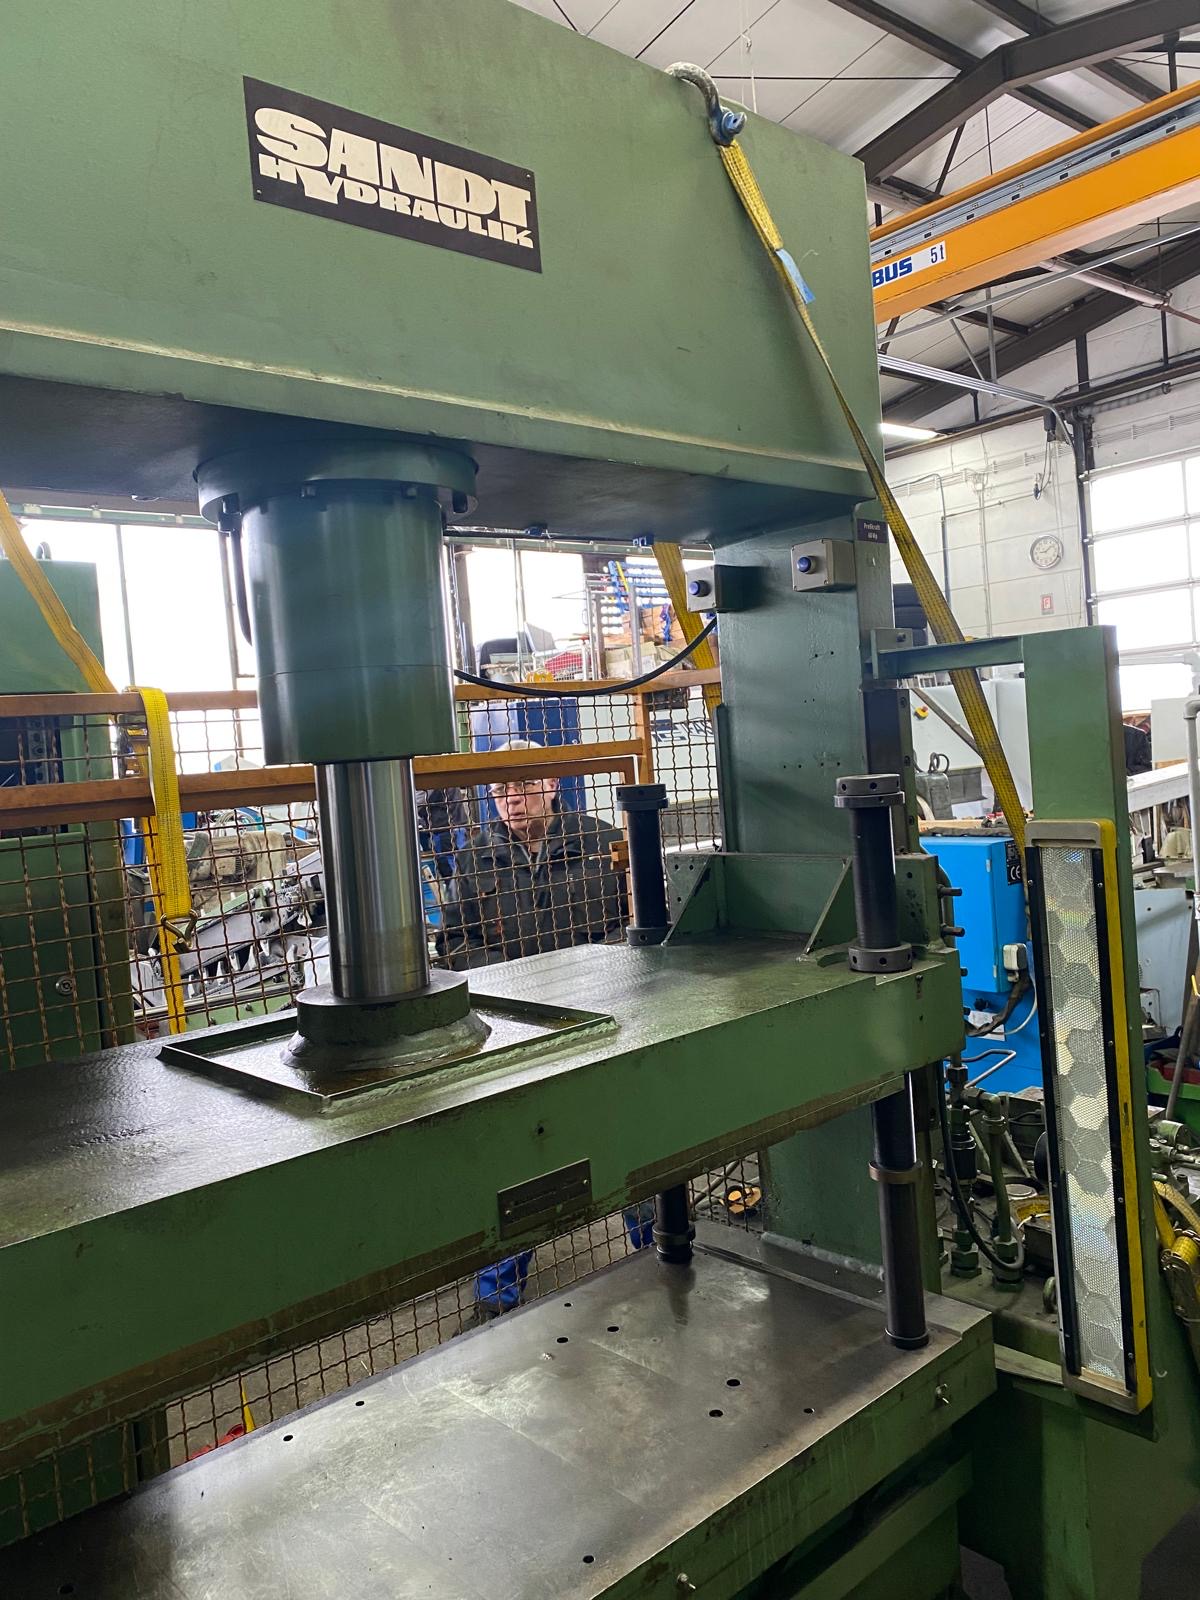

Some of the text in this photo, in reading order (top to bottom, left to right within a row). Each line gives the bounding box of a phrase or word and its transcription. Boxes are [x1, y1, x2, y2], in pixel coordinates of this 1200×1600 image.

[254, 107, 531, 228] SANDT
[258, 152, 534, 249] HYDRAULIK
[872, 256, 913, 288] BUS
